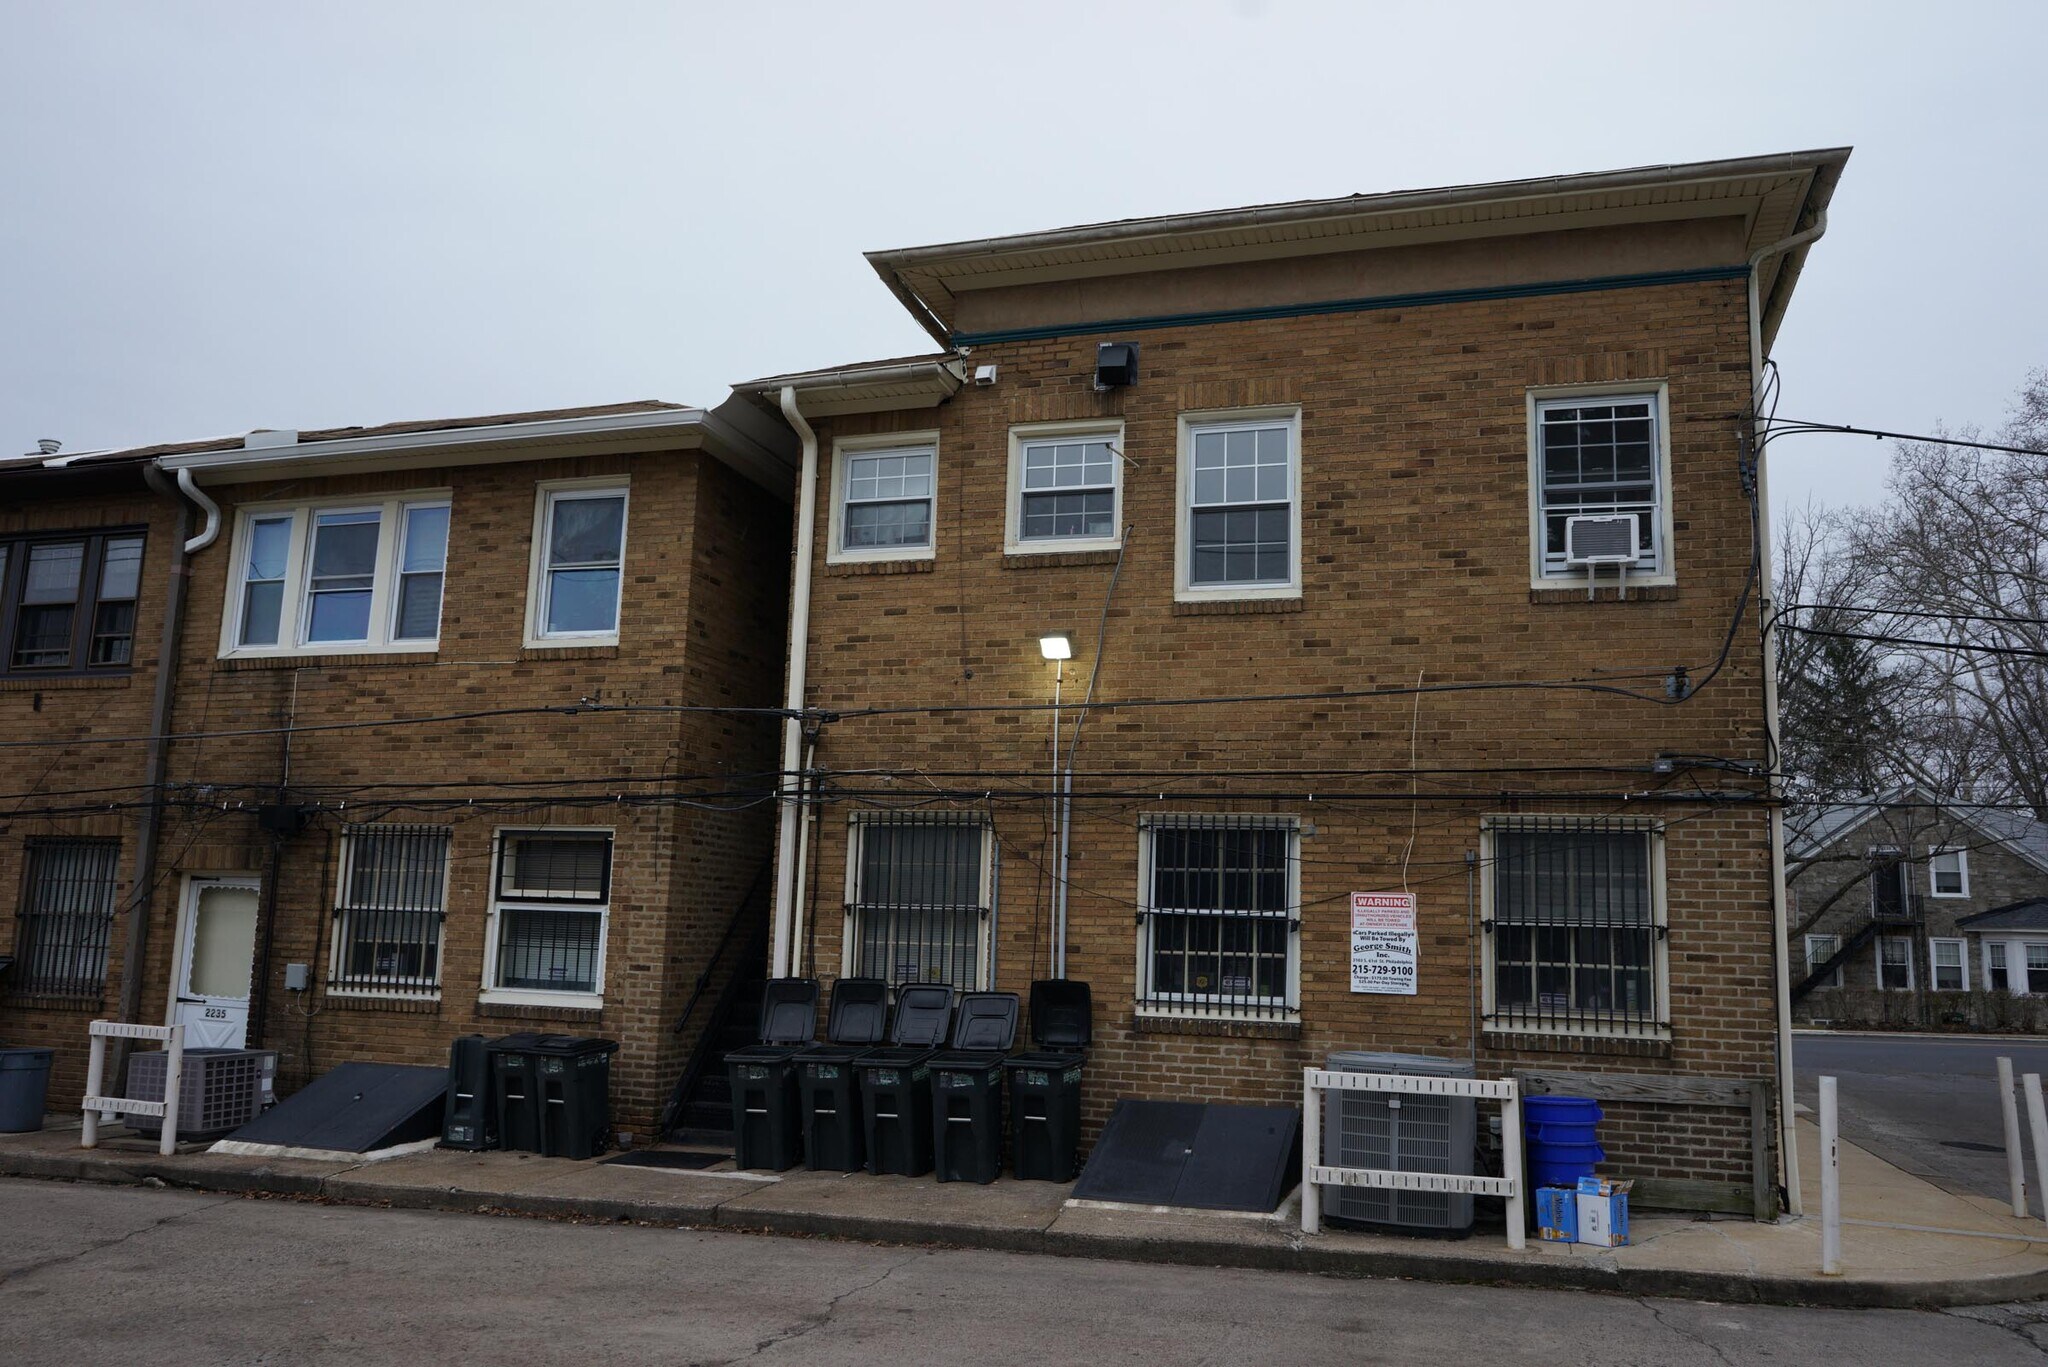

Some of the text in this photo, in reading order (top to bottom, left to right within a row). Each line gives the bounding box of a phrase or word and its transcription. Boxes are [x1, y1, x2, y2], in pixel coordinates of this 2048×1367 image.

[1357, 898, 1411, 907] WARNING
[1353, 942, 1411, 954] George Smith
[1352, 964, 1413, 976] 215-729-9100
[205, 1008, 227, 1019] 2235
